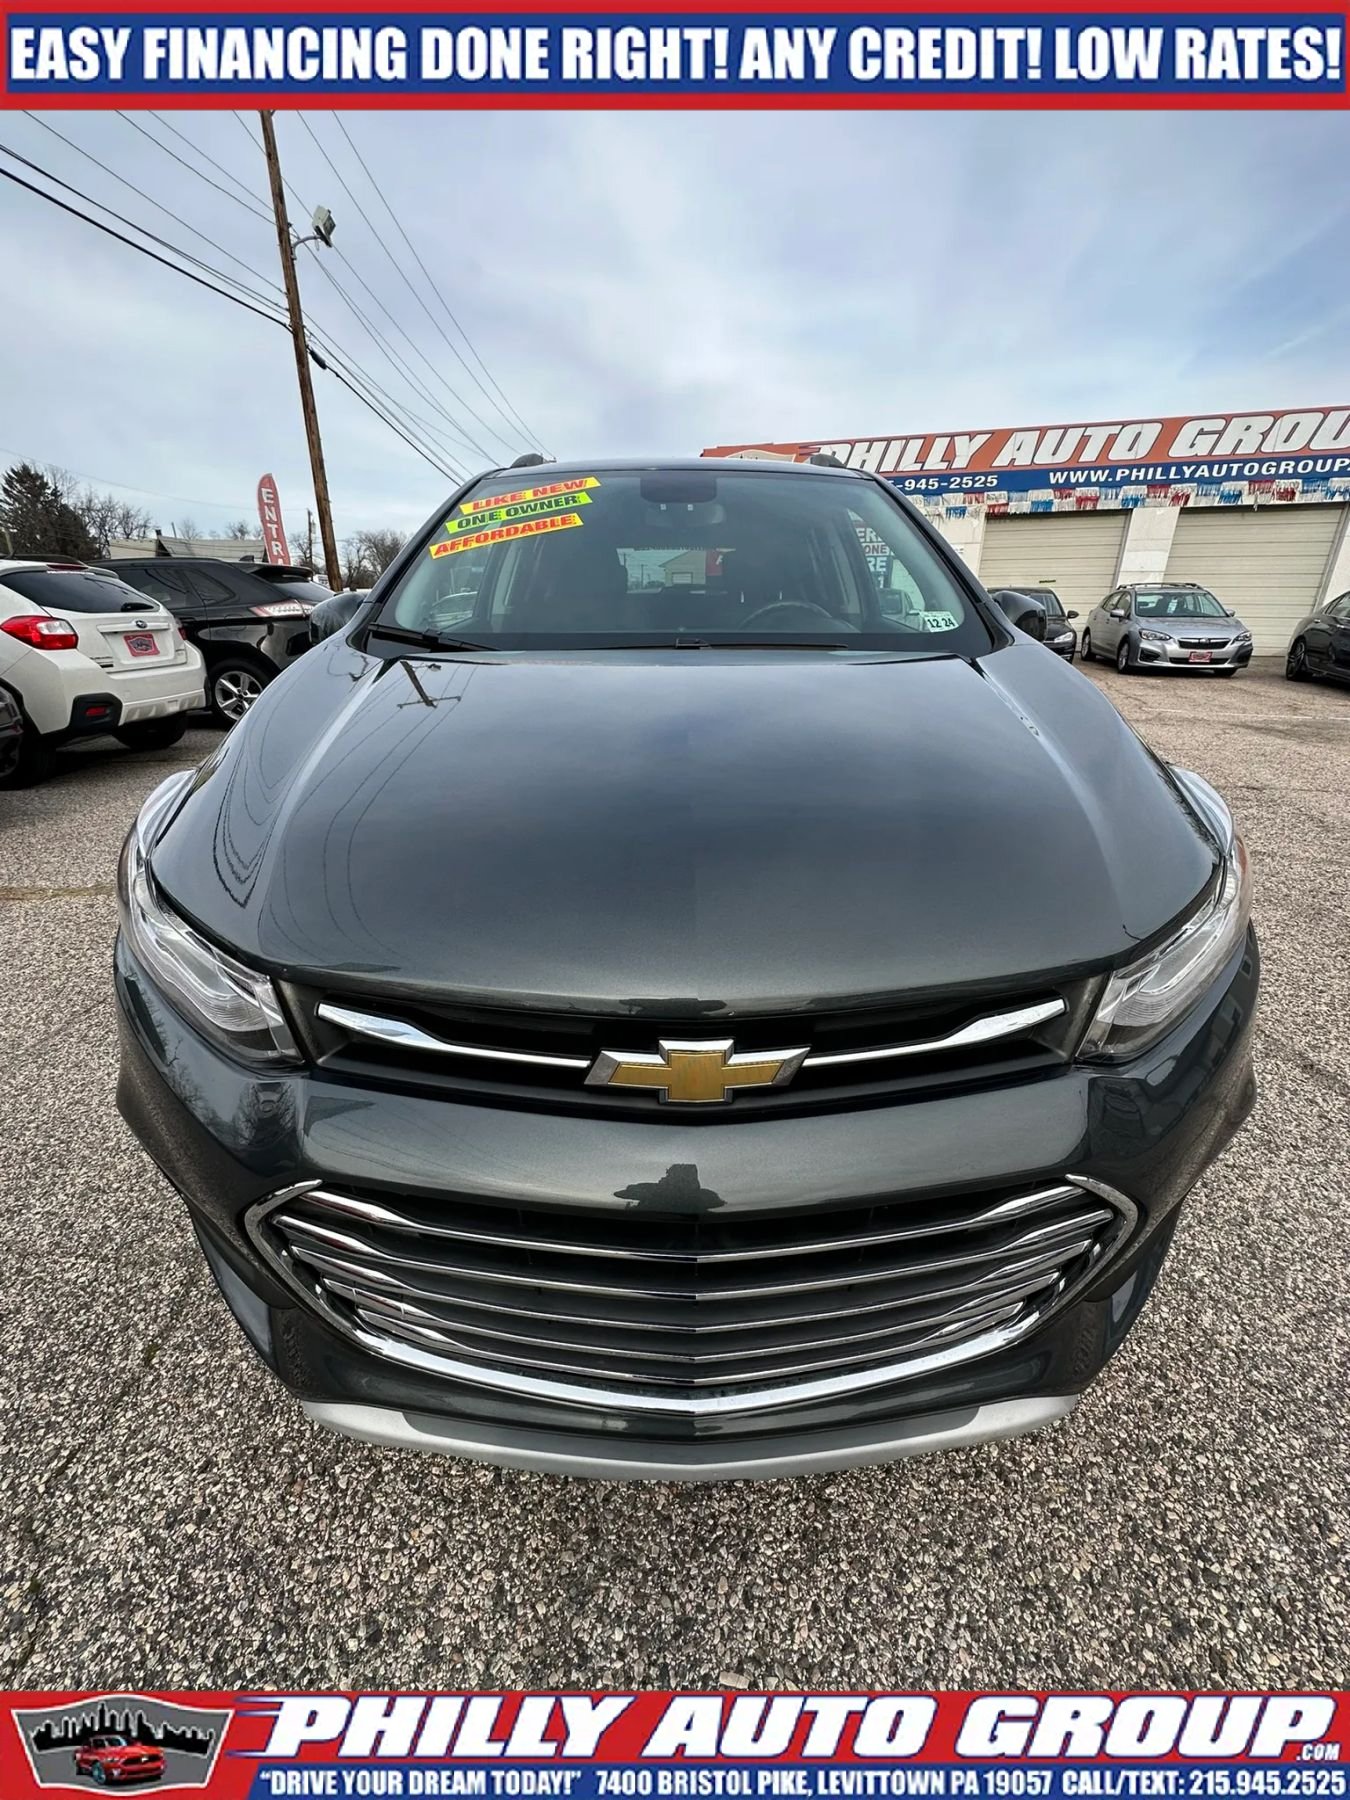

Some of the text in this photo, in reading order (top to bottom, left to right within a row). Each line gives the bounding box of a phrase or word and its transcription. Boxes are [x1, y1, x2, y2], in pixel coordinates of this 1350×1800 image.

[991, 422, 1162, 467] AUTO
[887, 475, 998, 490] -945-2525
[457, 494, 580, 530] ONE OWNER
[472, 491, 526, 511] LIKE
[434, 515, 577, 556] AFFORDABLE
